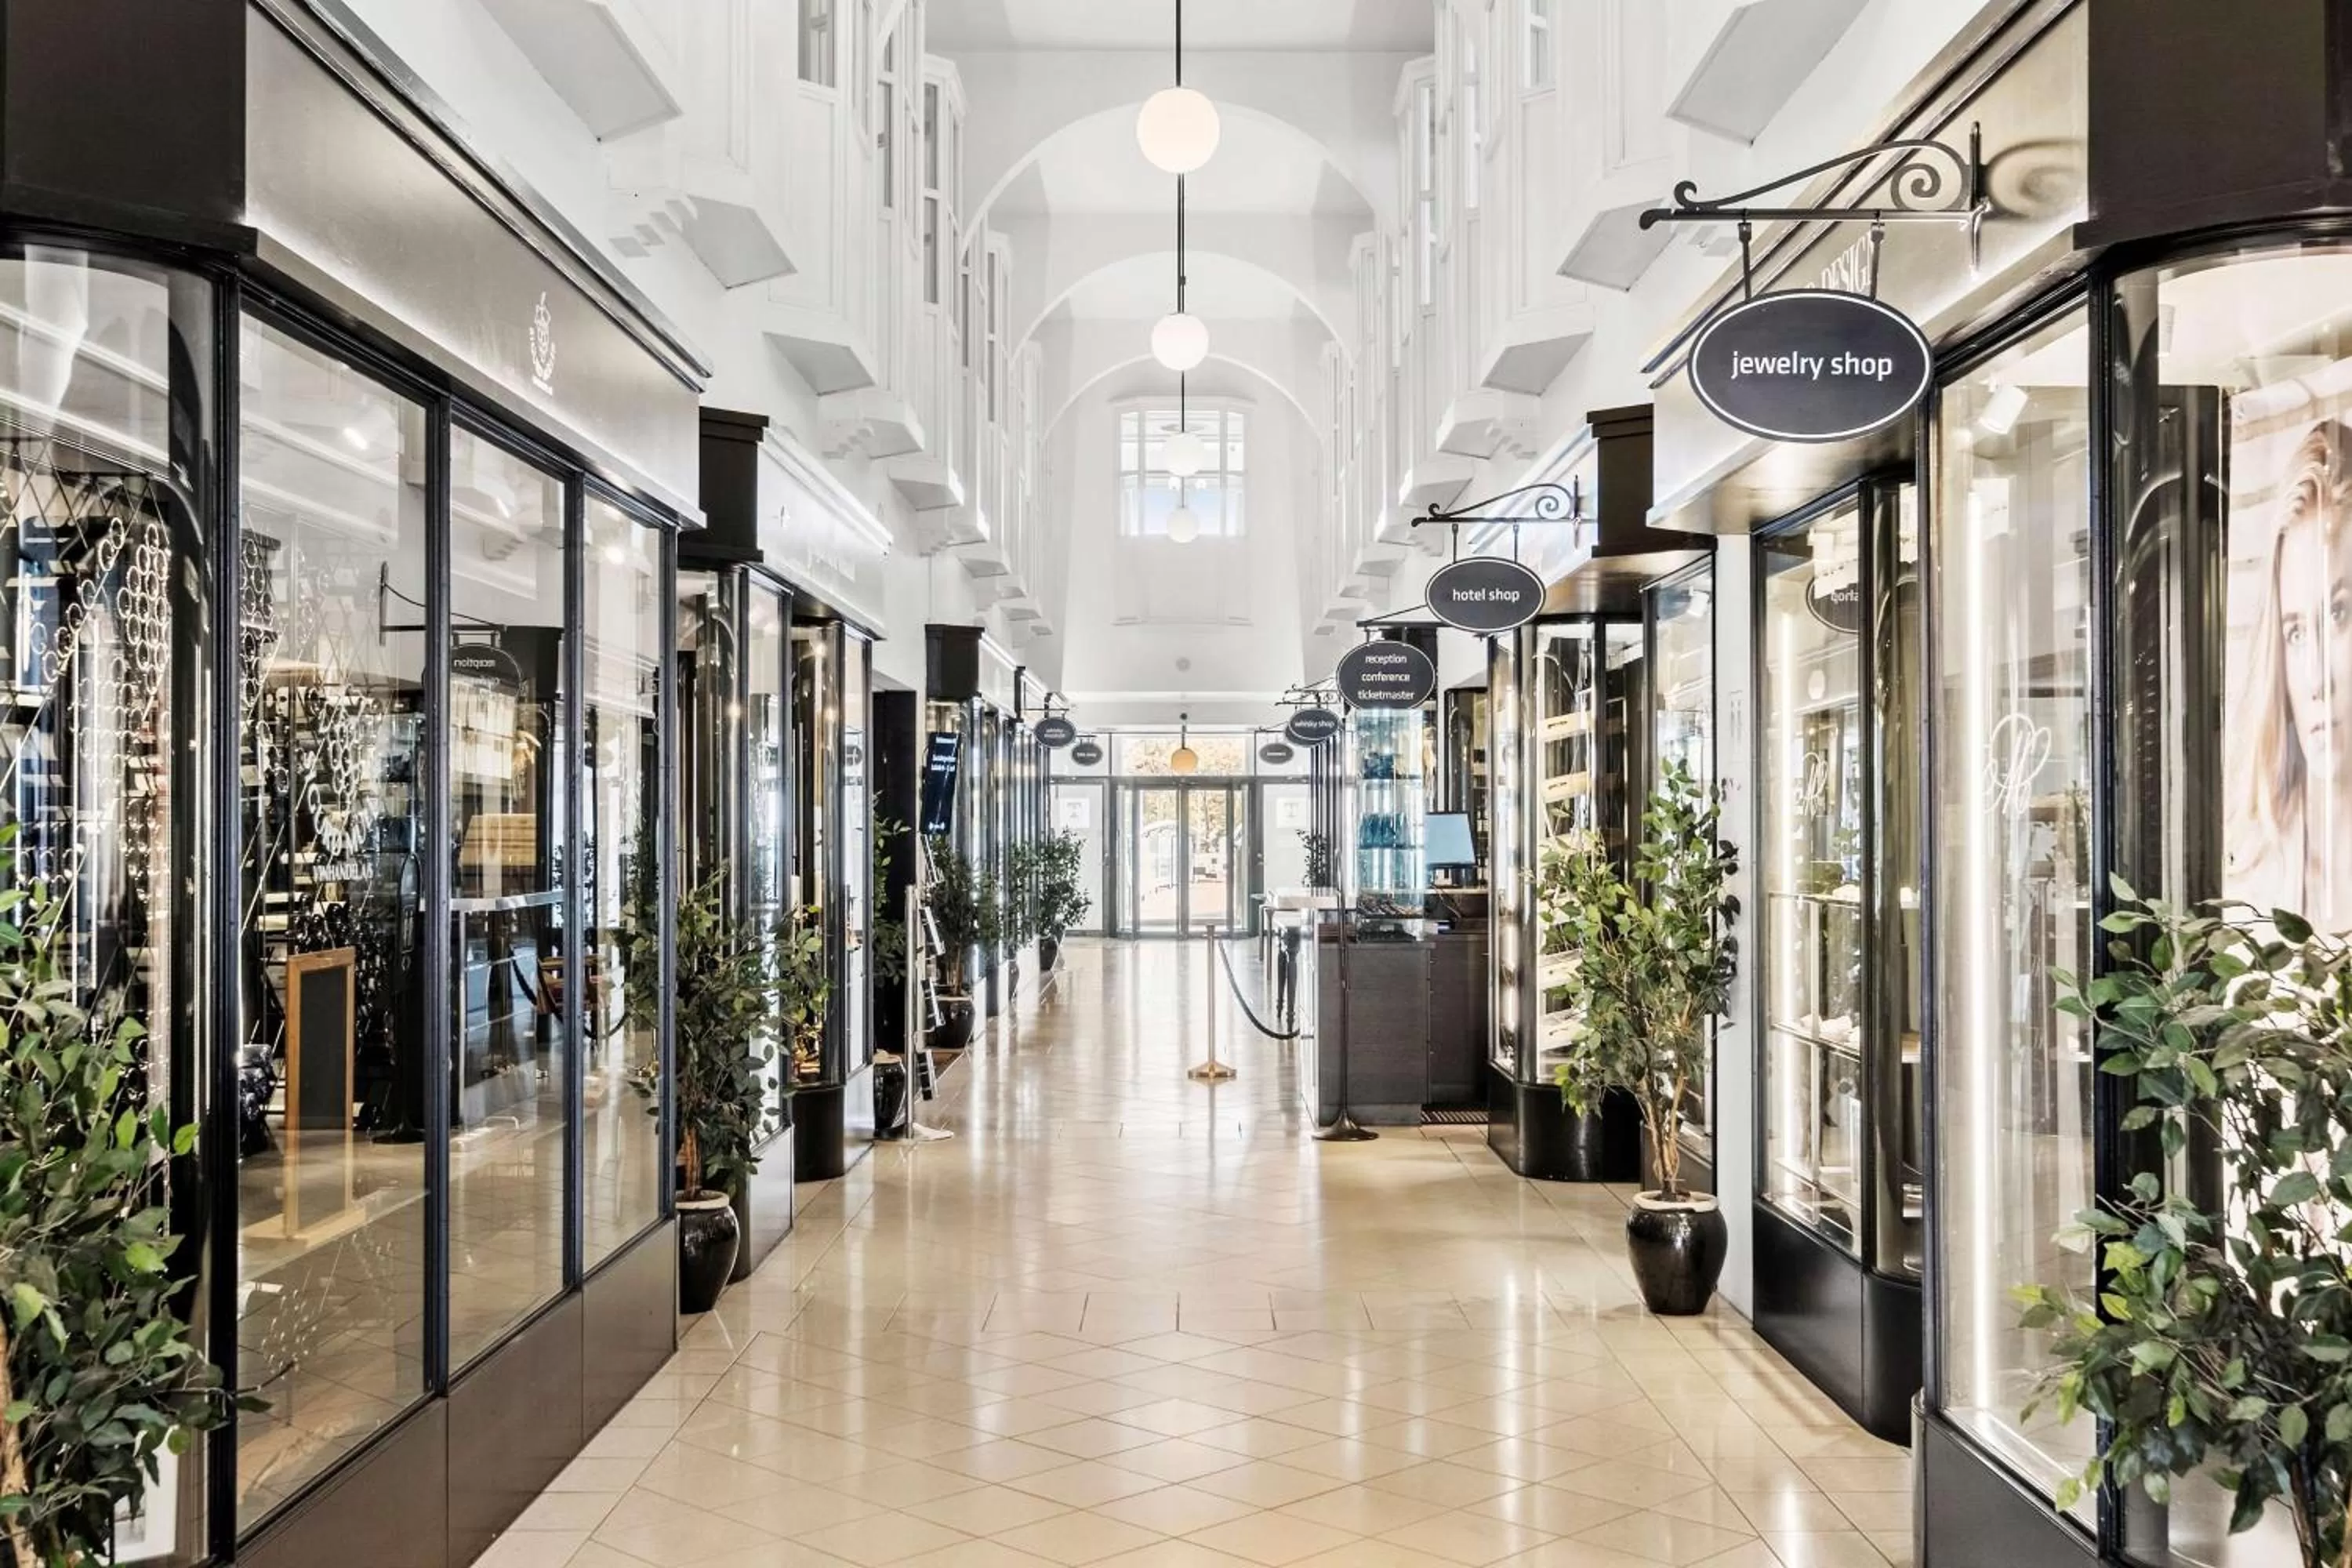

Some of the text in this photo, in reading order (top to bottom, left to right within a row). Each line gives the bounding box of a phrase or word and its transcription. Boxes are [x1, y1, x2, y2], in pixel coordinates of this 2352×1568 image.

[1730, 350, 1893, 381] jewelry shop
[1453, 588, 1520, 603] hotel shop
[1365, 654, 1407, 665] reception
[1361, 673, 1410, 682] conference
[1358, 690, 1414, 700] ticketmaster
[1319, 720, 1335, 729] shop
